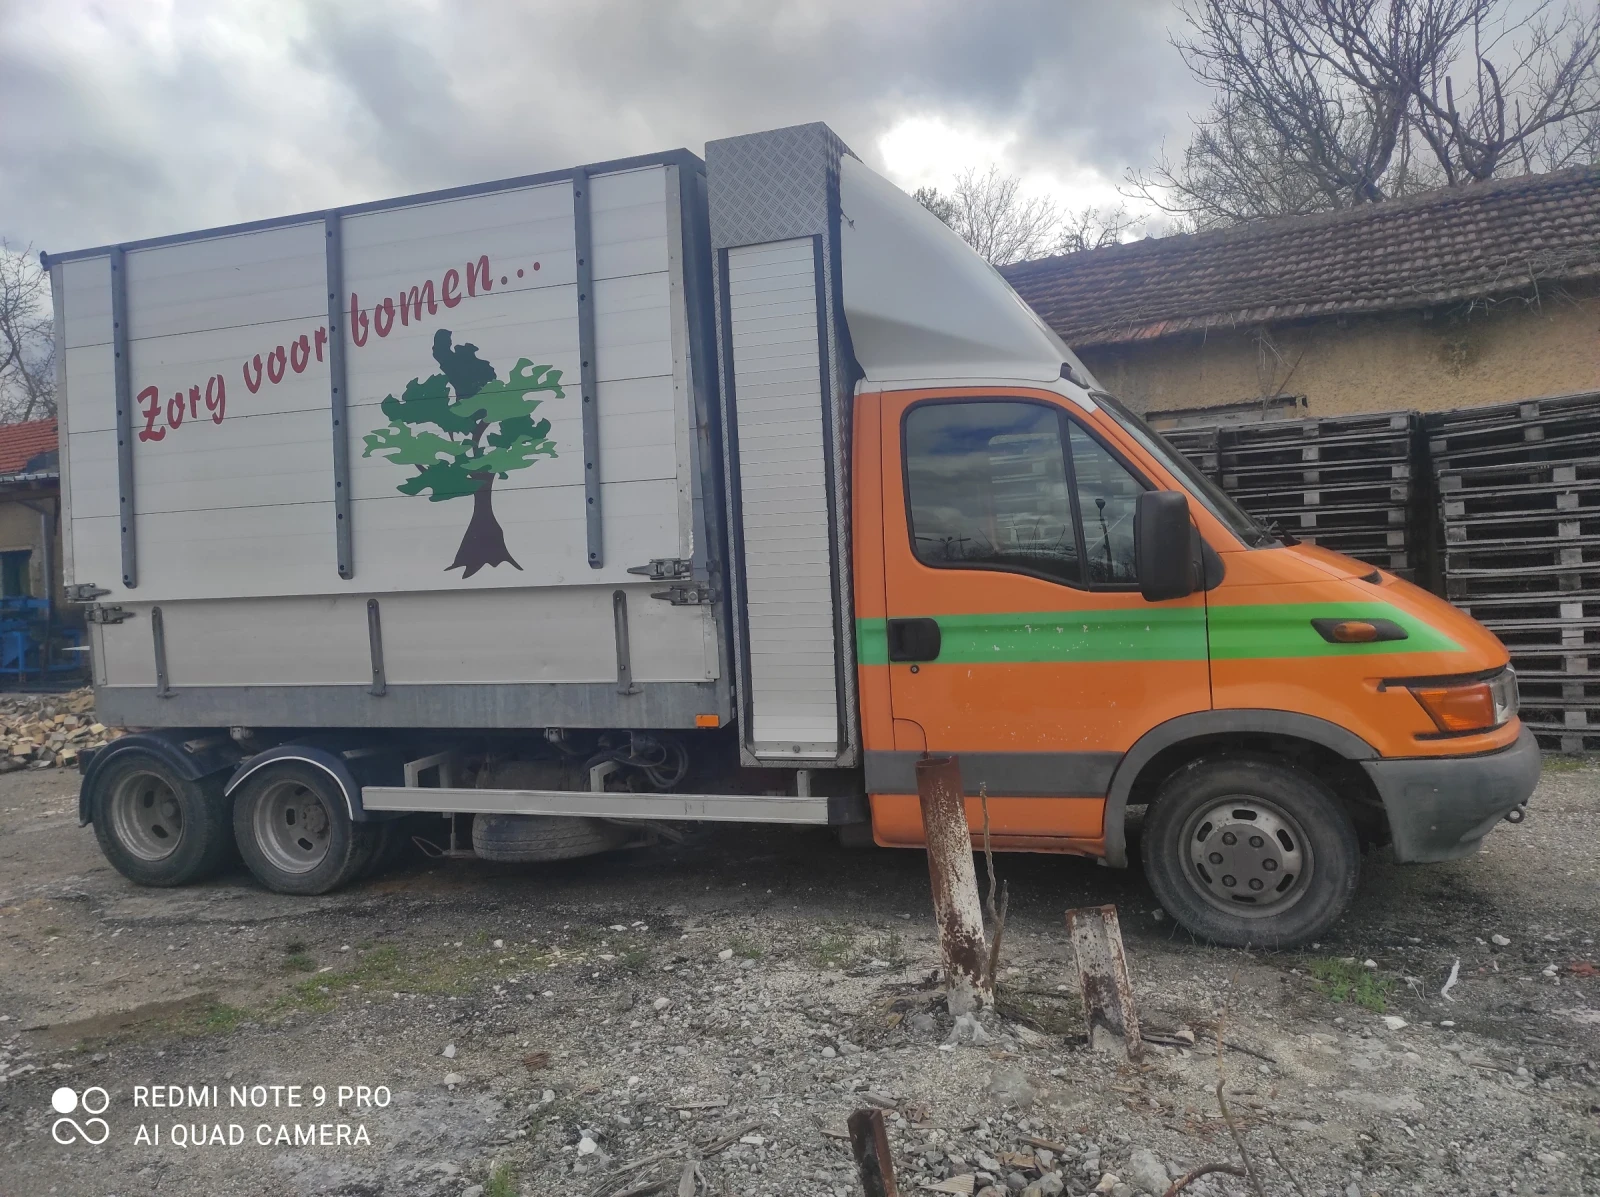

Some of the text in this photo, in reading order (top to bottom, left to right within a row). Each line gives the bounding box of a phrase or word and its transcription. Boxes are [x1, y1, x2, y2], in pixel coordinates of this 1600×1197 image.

[137, 255, 541, 442] Zorg voor bomen...
